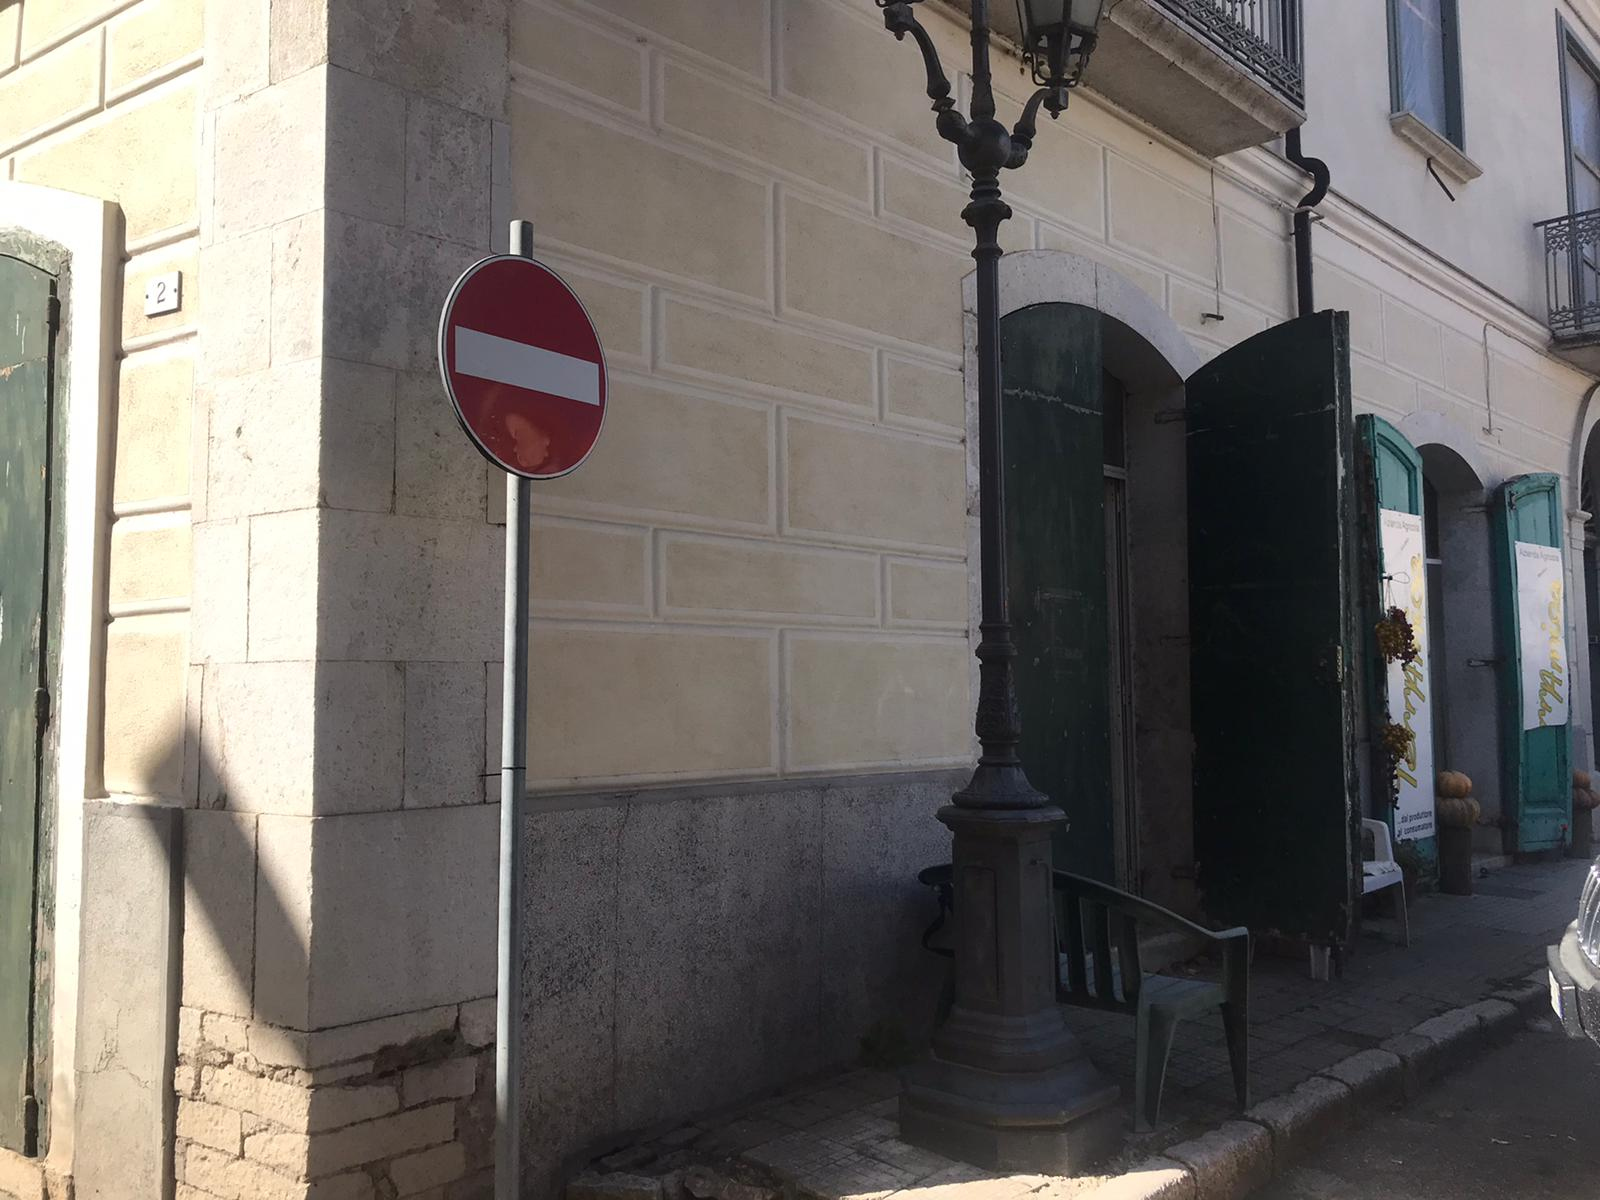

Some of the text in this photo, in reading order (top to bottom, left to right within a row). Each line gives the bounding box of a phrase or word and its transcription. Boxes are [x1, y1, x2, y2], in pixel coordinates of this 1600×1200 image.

[157, 281, 166, 304] 2
[1409, 810, 1432, 823] produttore
[1404, 822, 1432, 835] consumatore
